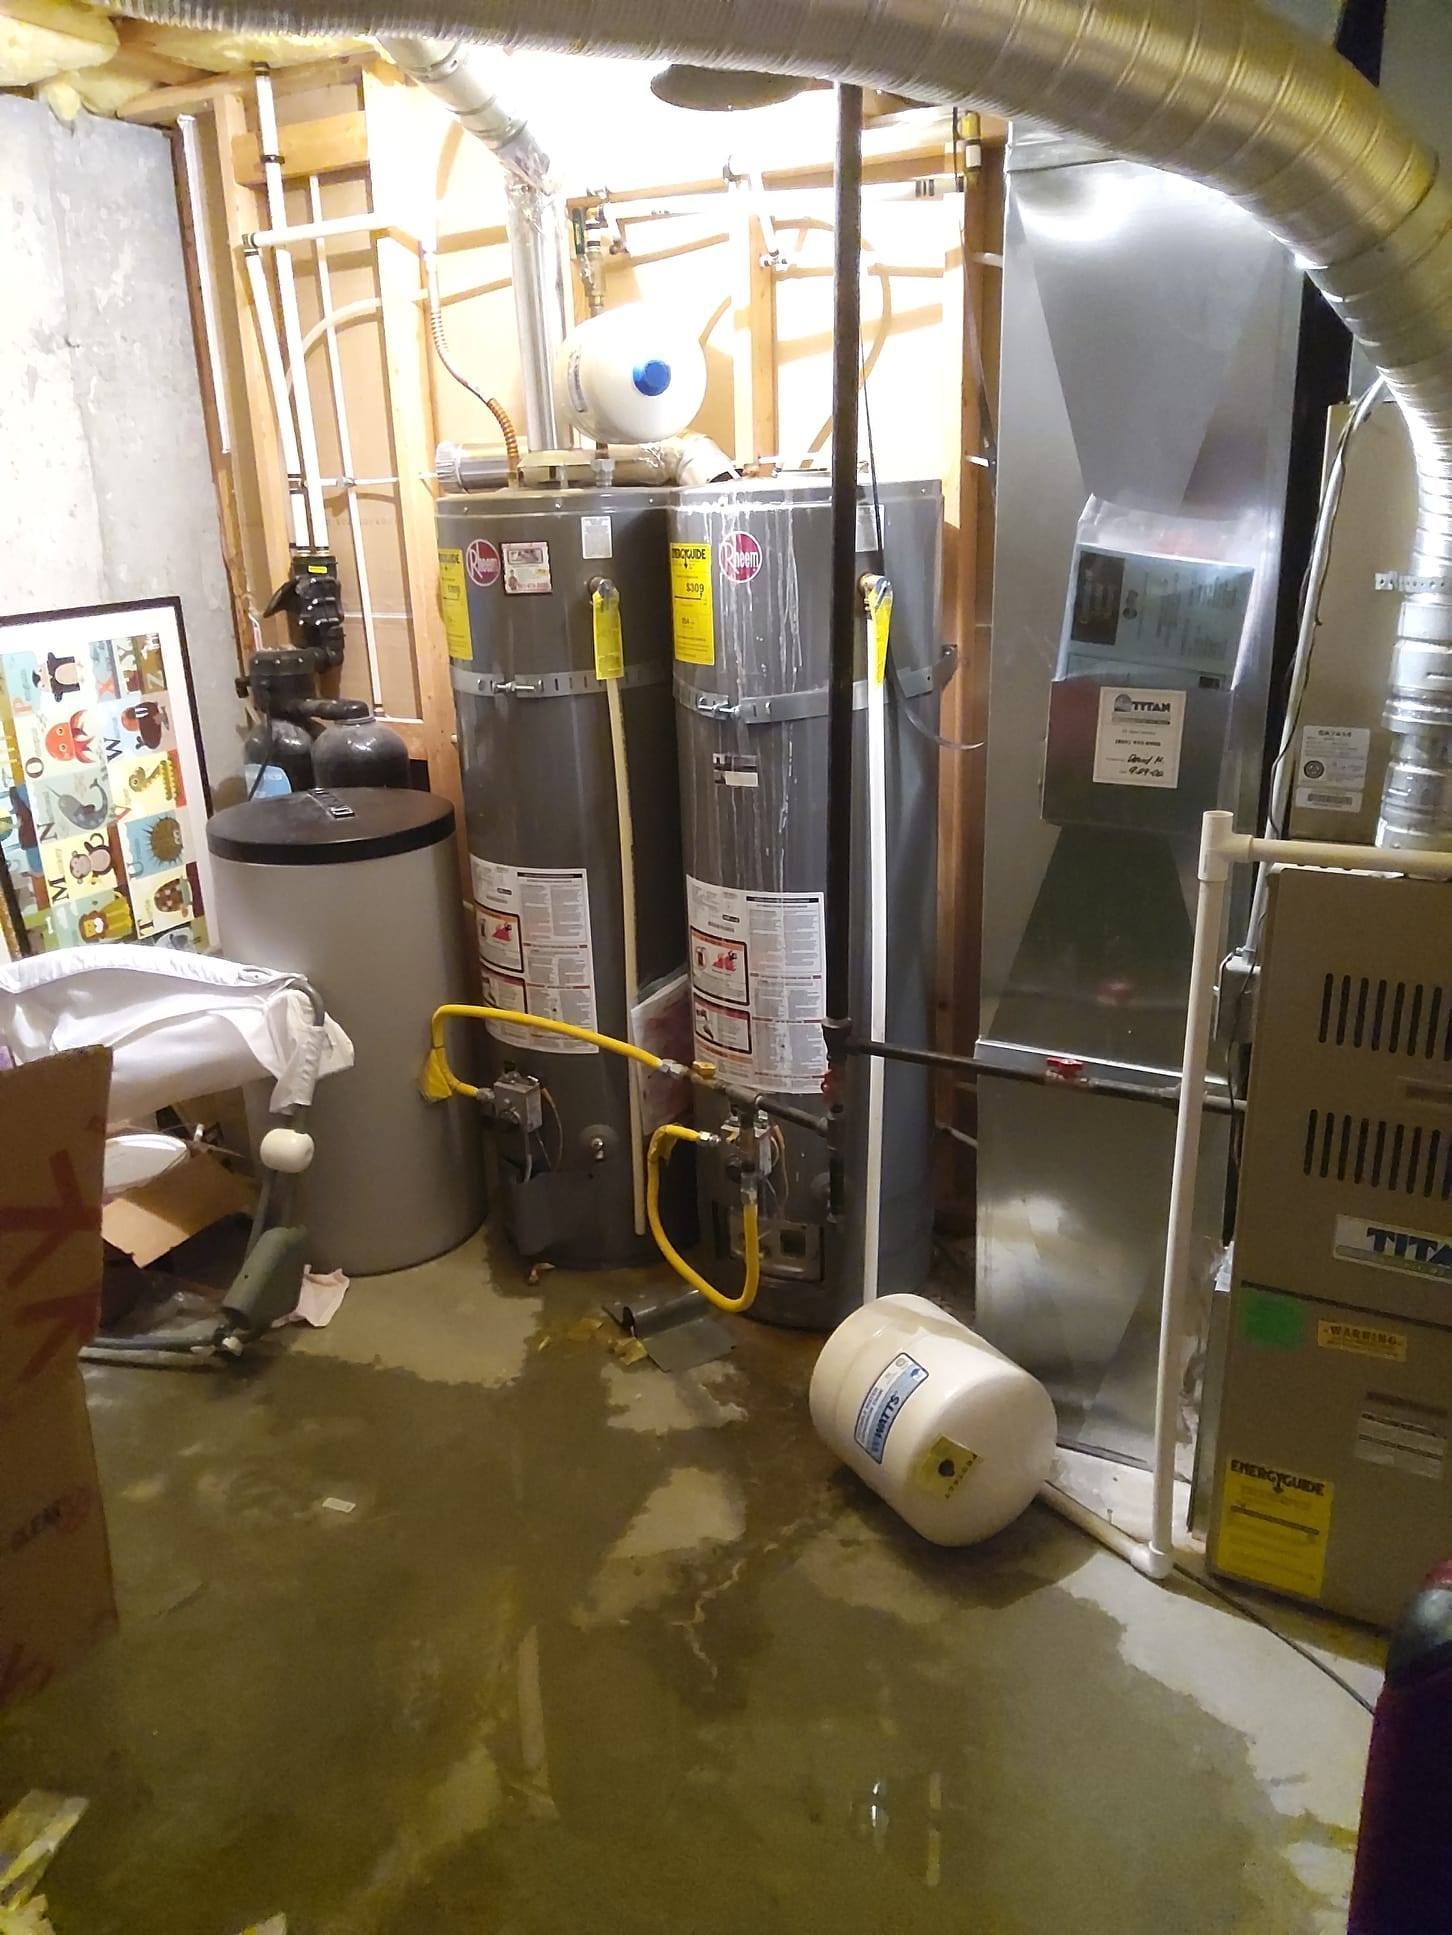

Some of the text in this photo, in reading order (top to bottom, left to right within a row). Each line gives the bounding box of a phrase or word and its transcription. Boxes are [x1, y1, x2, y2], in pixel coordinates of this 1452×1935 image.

[721, 534, 759, 576] Rheem
[25, 757, 44, 778] O
[37, 822, 58, 842] N
[48, 877, 70, 902] M
[137, 918, 155, 937] T
[1330, 1325, 1398, 1345] WARNING
[875, 1393, 900, 1440] WATTS
